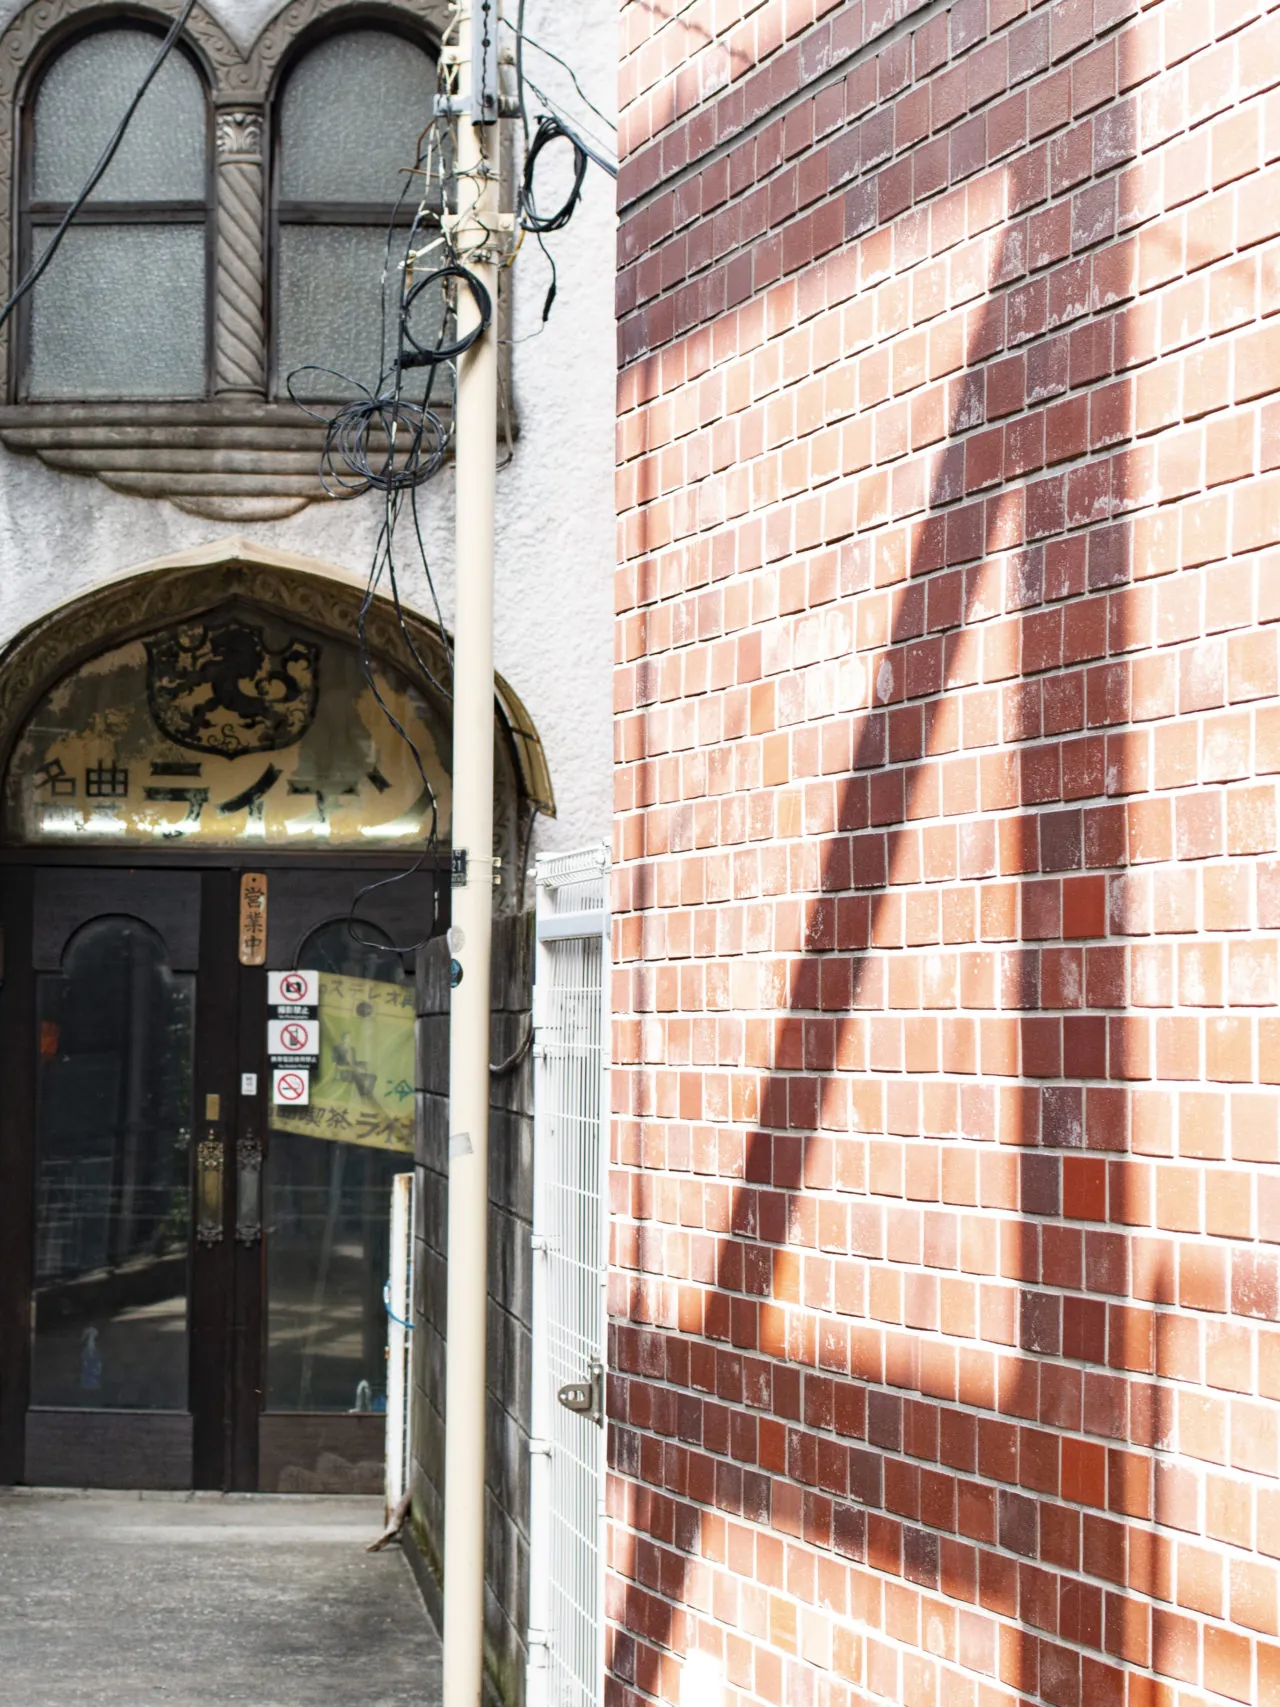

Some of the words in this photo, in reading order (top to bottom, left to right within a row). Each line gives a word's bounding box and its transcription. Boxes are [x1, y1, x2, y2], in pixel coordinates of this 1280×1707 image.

[33, 758, 128, 797] 名曲
[243, 886, 265, 957] 営業中
